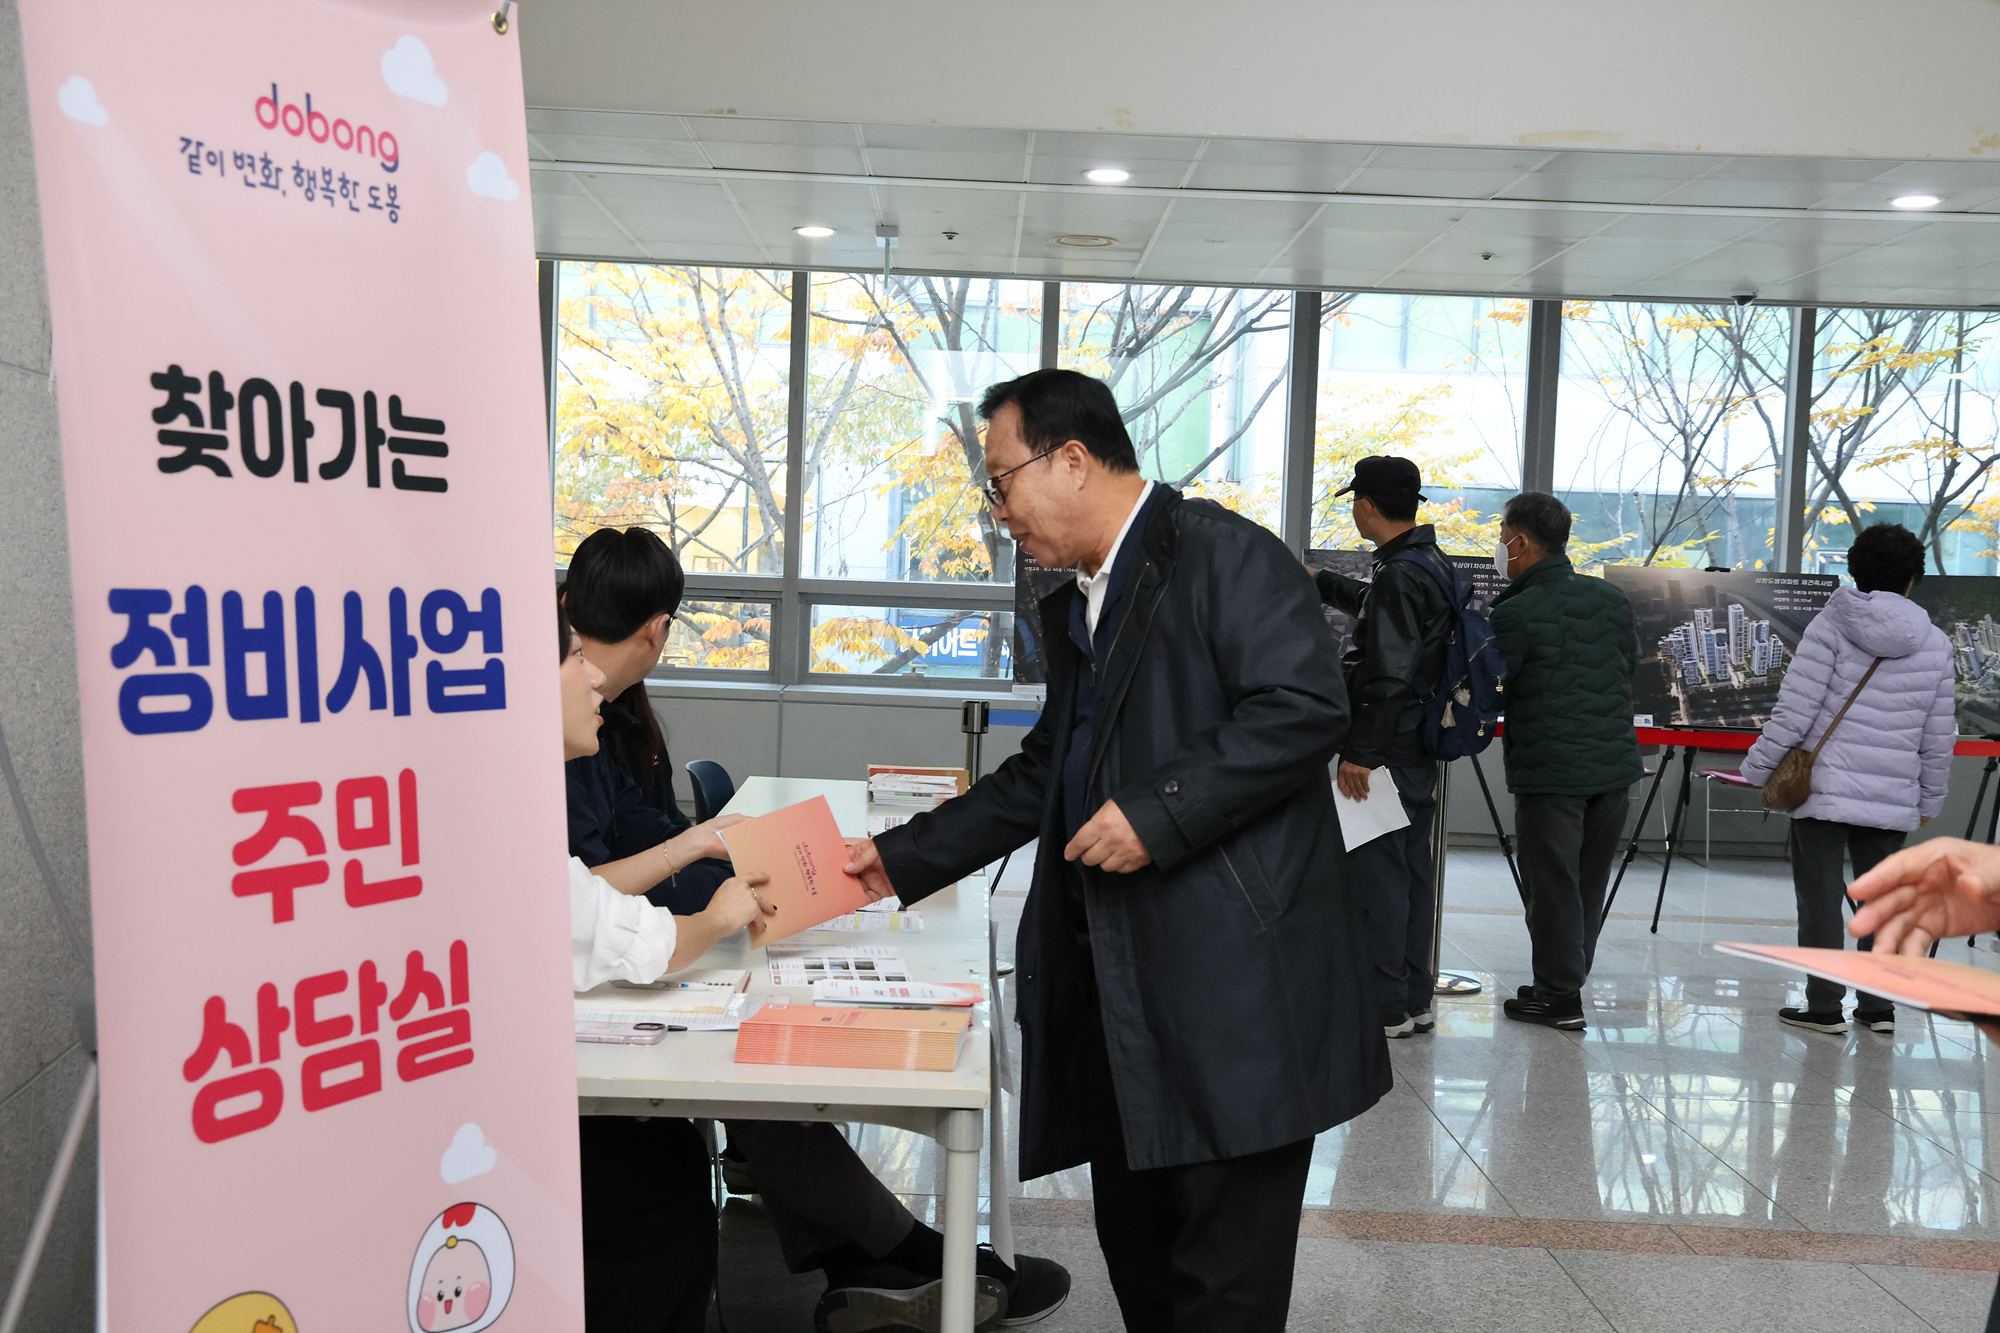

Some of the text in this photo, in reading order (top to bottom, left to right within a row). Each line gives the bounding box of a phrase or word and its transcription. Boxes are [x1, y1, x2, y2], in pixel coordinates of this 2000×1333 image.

[179, 136, 401, 223] 같이 변화, 행복한 도봉
[255, 83, 399, 173] dobong
[150, 364, 449, 493] 찾아가는
[1801, 579, 1833, 587] 재건축사업
[108, 584, 507, 735] 정비사업
[231, 768, 423, 923] 주민
[182, 939, 474, 1144] 상담실
